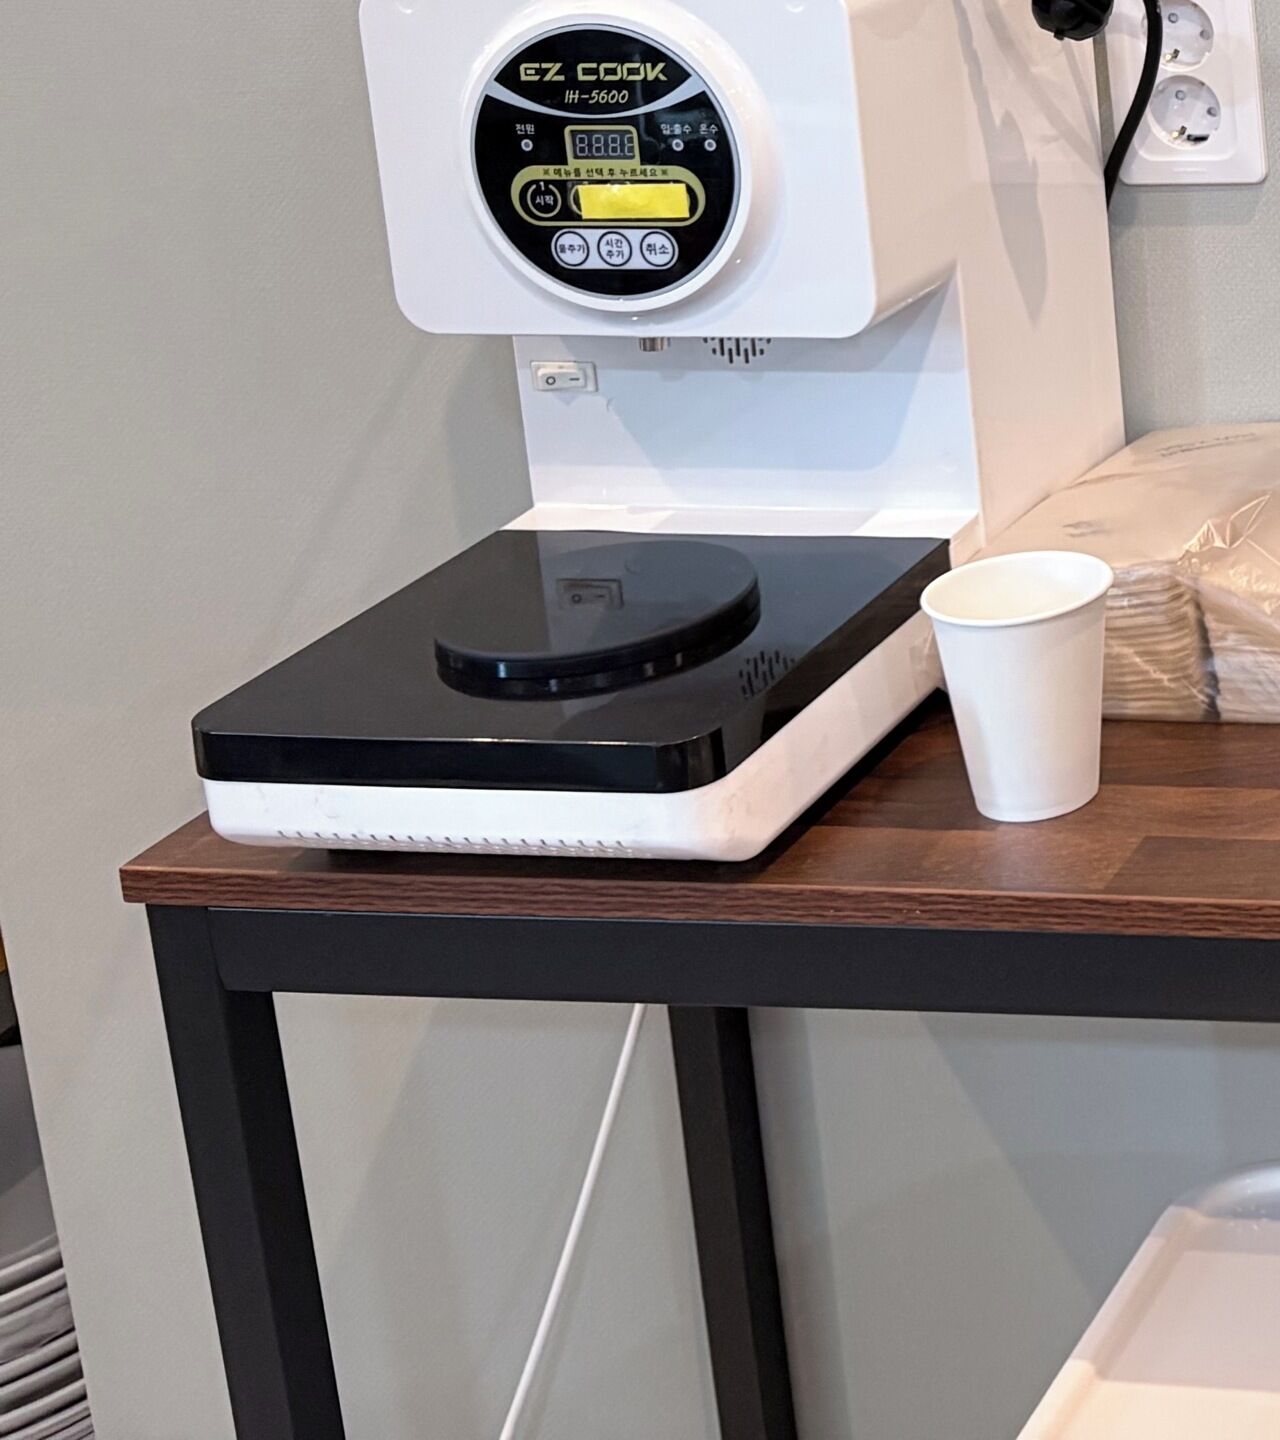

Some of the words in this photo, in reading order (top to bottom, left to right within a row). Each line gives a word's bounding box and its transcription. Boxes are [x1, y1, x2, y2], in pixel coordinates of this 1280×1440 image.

[519, 62, 565, 81] EZ
[576, 62, 668, 81] COOK
[564, 89, 629, 104] IH-5600
[539, 181, 545, 191] 1
[535, 195, 554, 206] 시작
[605, 238, 623, 249] 시간
[645, 243, 670, 256] 취소
